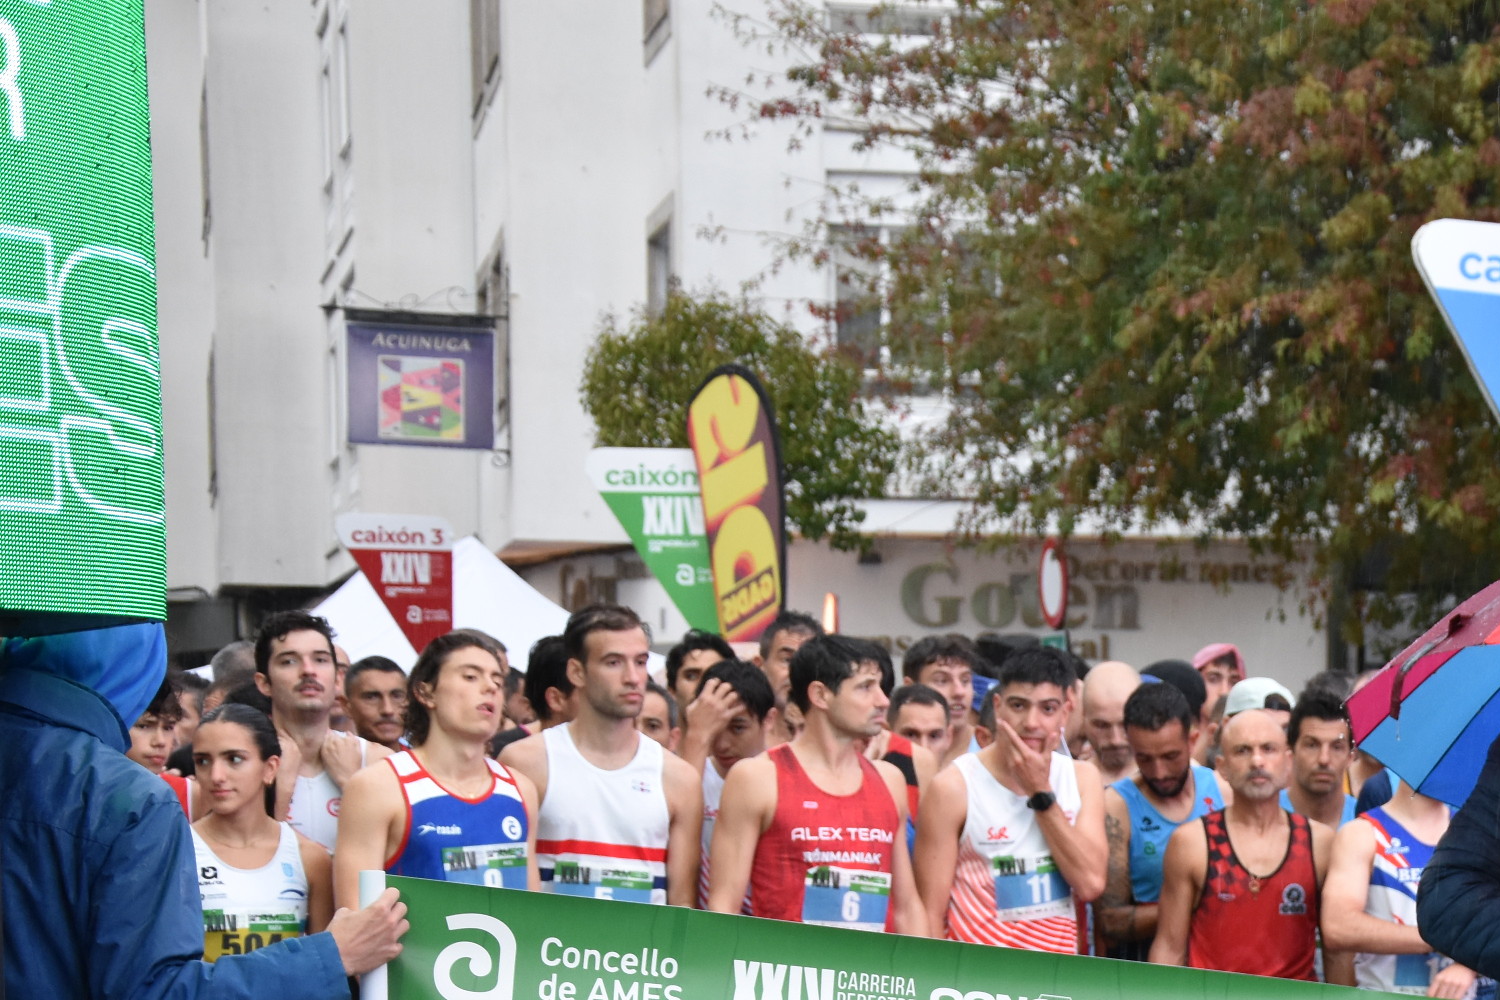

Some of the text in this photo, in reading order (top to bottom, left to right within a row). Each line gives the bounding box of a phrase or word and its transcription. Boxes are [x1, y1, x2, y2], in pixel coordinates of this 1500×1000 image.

[372, 332, 471, 352] ACUINUGA
[605, 464, 698, 486] caixón
[641, 496, 706, 536] XXIV
[351, 526, 444, 544] caixón 3
[380, 552, 432, 585] XXIV
[791, 827, 894, 844] ALEX TEAM
[1026, 873, 1052, 904] 11
[841, 890, 860, 922] 6
[540, 937, 679, 979] Concello
[837, 970, 917, 997] CARREIRA
